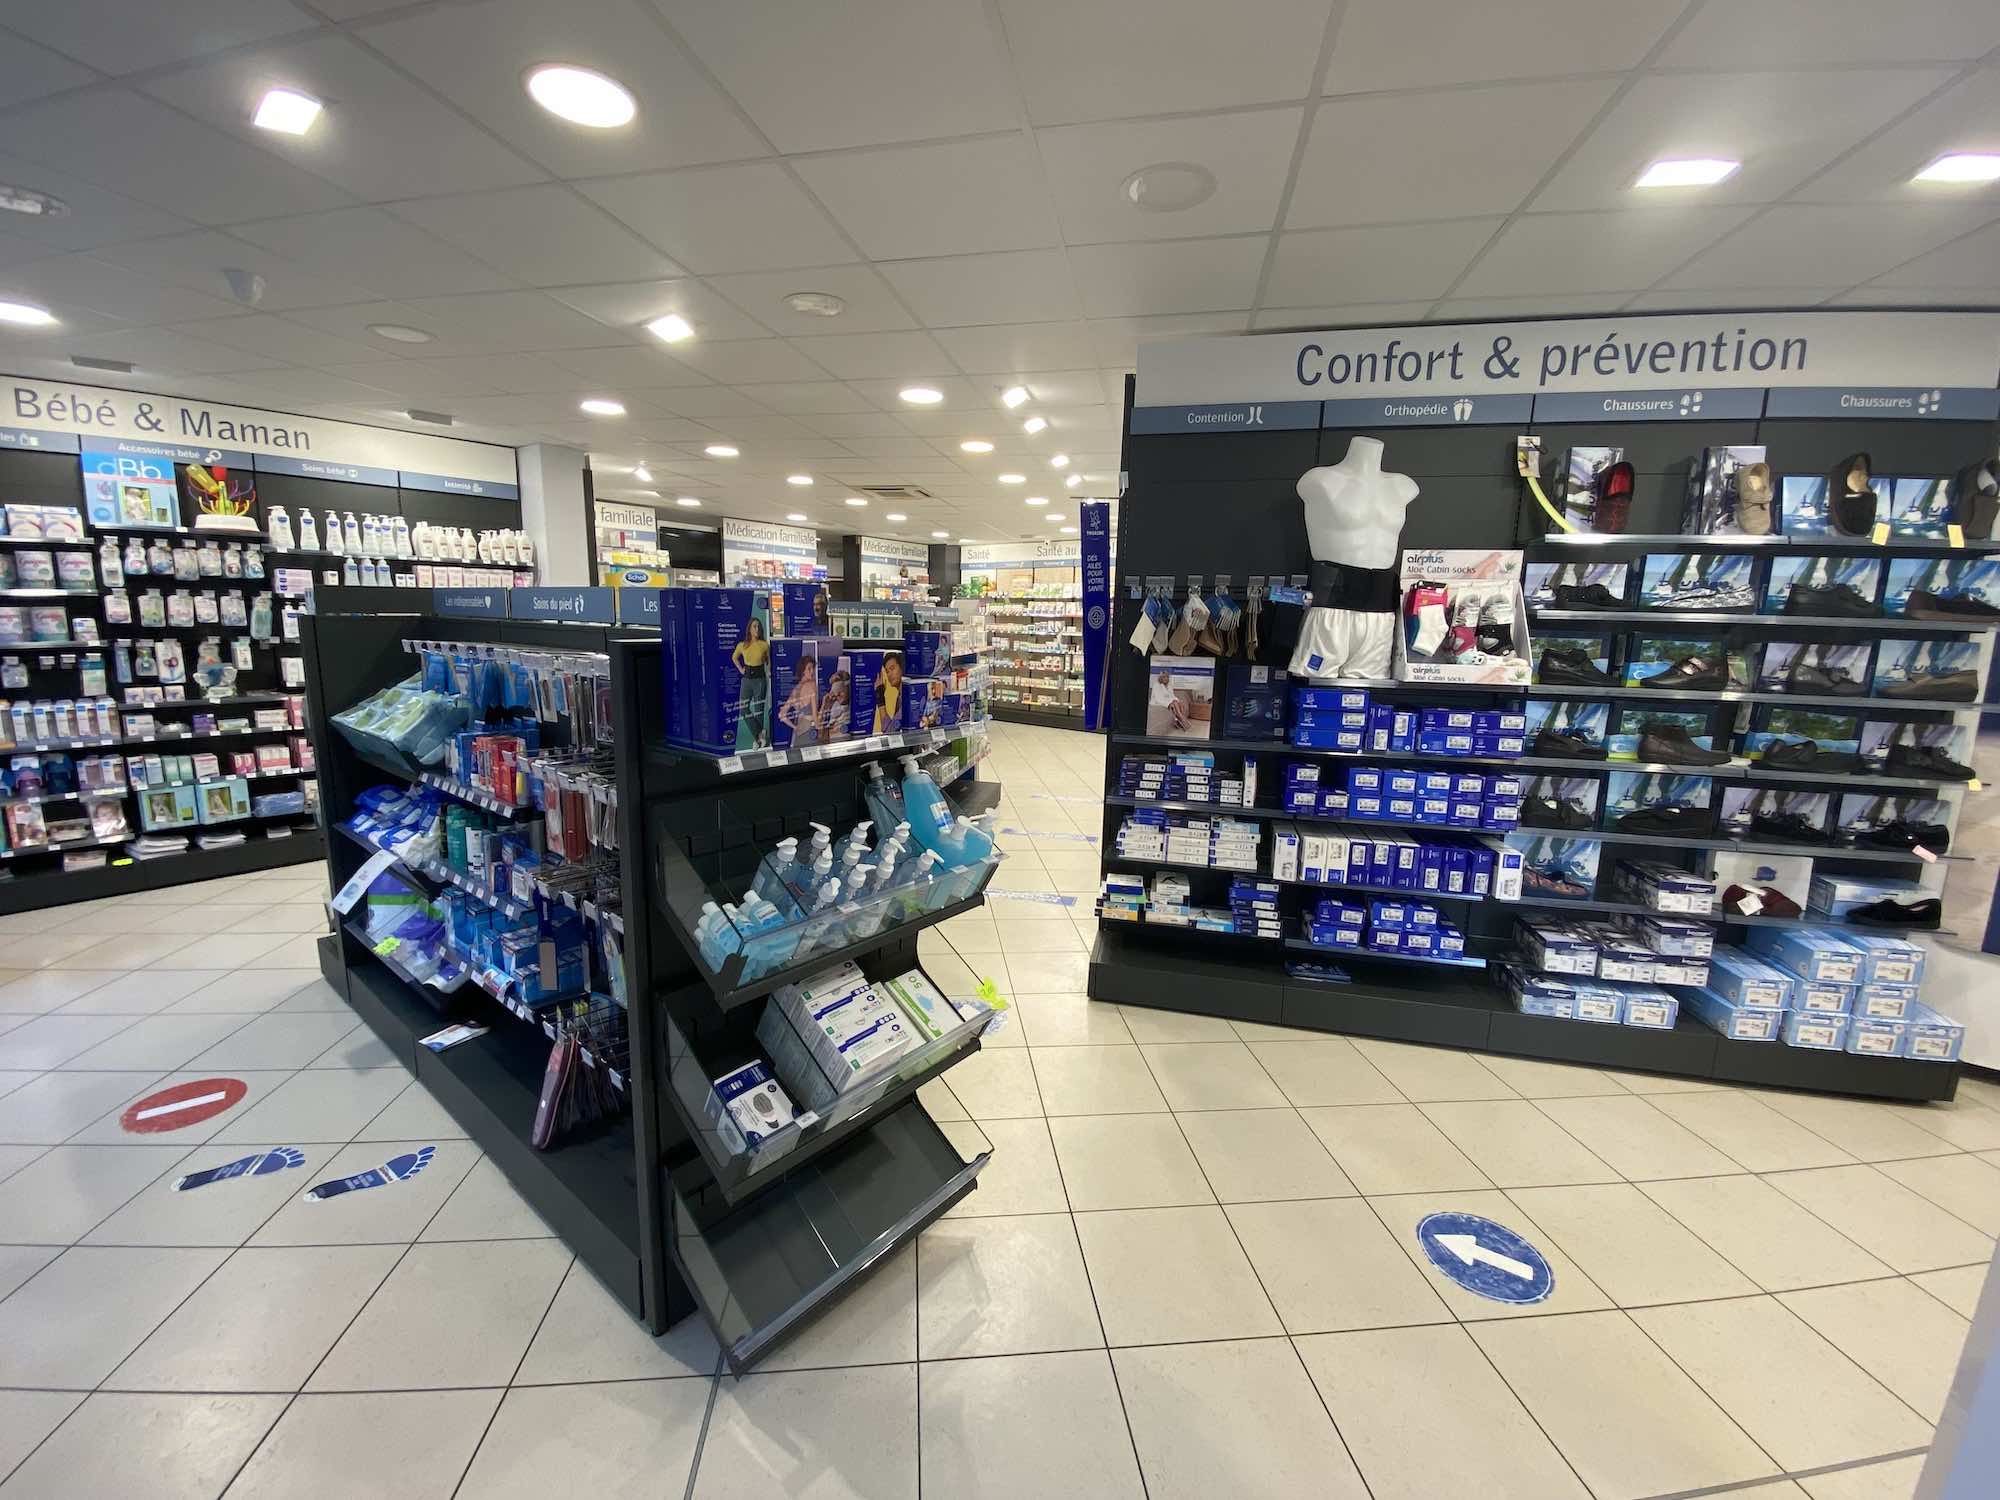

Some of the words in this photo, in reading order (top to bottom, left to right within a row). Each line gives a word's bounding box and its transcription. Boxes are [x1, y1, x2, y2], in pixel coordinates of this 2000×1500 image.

[1296, 340, 1464, 386] Confort
[1483, 335, 1521, 379] &
[1537, 331, 1808, 386] prévention
[1602, 398, 1674, 413] Chaussures
[1840, 394, 1912, 408] Chaussures
[1187, 410, 1244, 425] Contention
[1384, 403, 1448, 418] Orthopédie
[13, 387, 116, 427] Bébé
[134, 402, 165, 433] &
[180, 408, 311, 450] Maman
[118, 442, 175, 457] Accessoires
[177, 448, 200, 459] bébé
[97, 457, 162, 480] dBb
[600, 503, 654, 527] familiale
[967, 548, 991, 561] Santé
[1036, 545, 1062, 557] Santé
[1065, 547, 1077, 558] au
[1407, 554, 1444, 566] airplus
[1427, 566, 1450, 574] Cabin
[1452, 566, 1477, 574] socks
[533, 596, 549, 610] Soins
[550, 597, 558, 610] du
[559, 597, 573, 612] pied
[643, 596, 658, 612] Les
